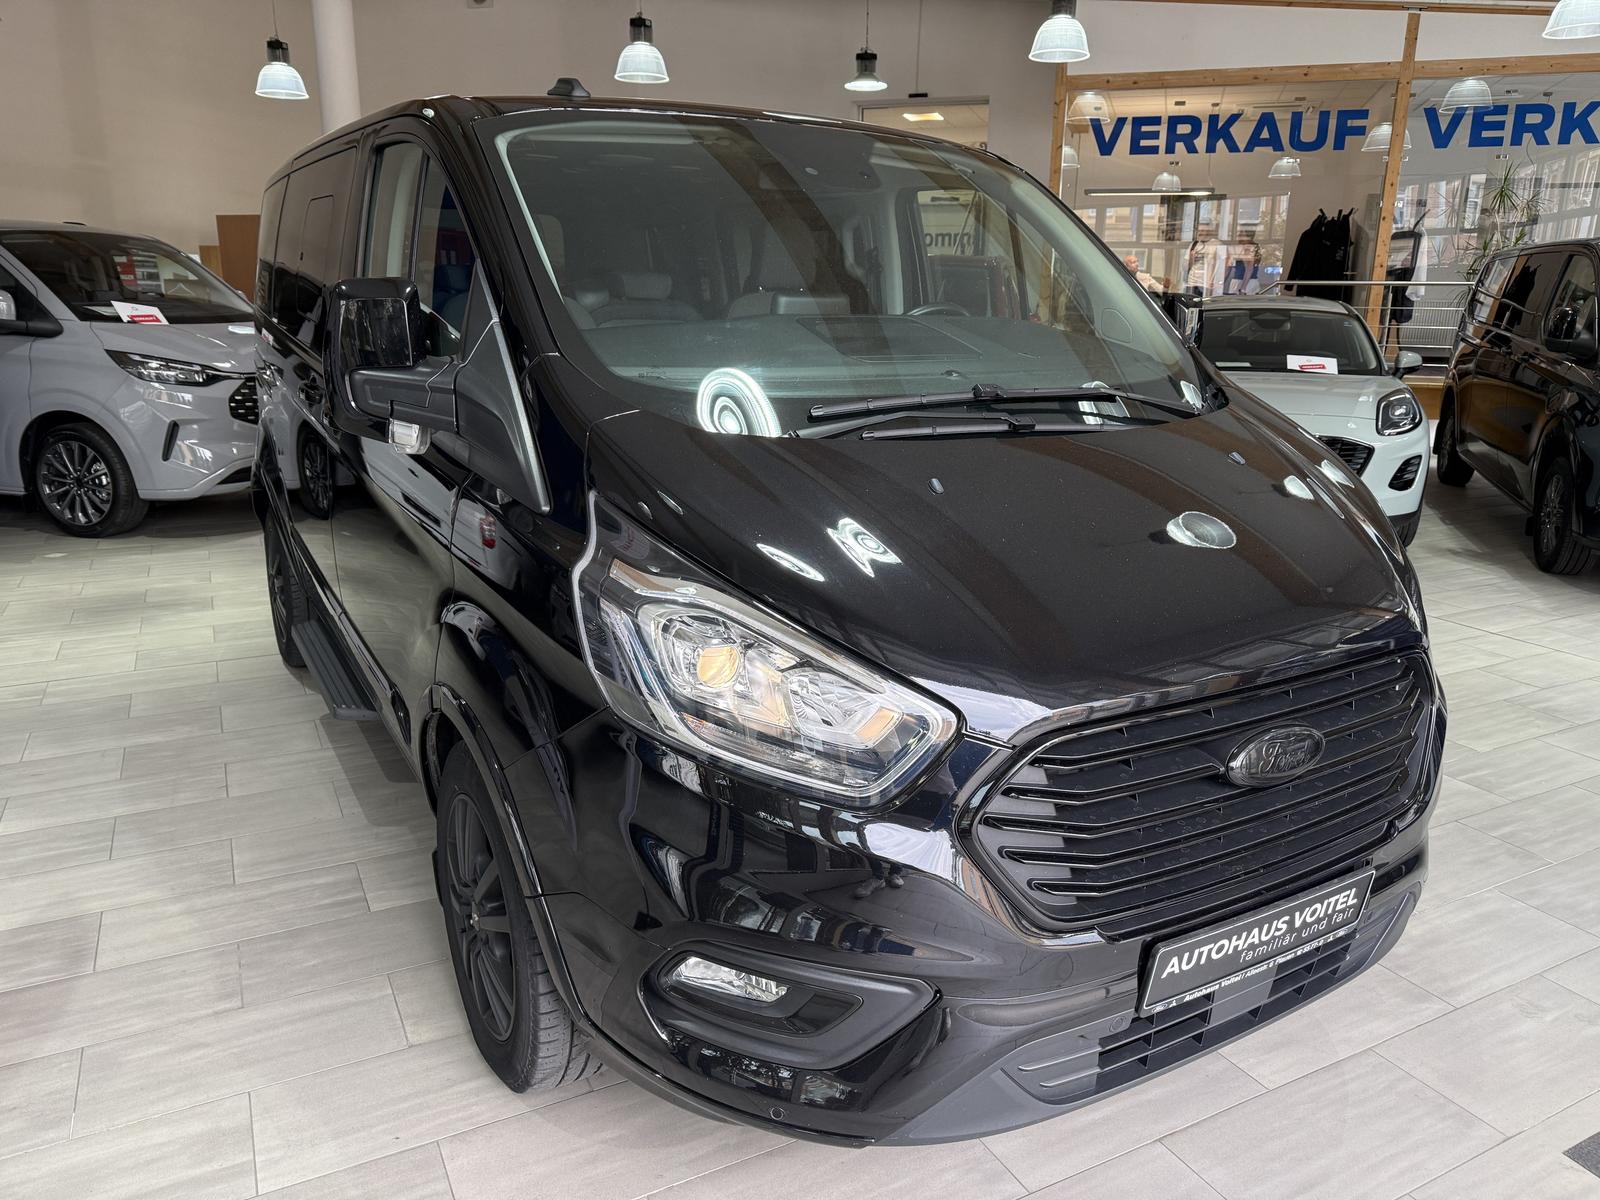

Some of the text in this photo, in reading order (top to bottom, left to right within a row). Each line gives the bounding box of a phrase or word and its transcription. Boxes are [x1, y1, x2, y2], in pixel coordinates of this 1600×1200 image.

[1089, 109, 1370, 156] VERKAUF
[1423, 101, 1600, 149] VERK
[1259, 737, 1309, 776] Ford
[1161, 888, 1358, 979] AUTOHAUS VOITEL
[1240, 932, 1297, 963] familiär
[1301, 917, 1328, 937] und
[1331, 908, 1354, 925] fair
